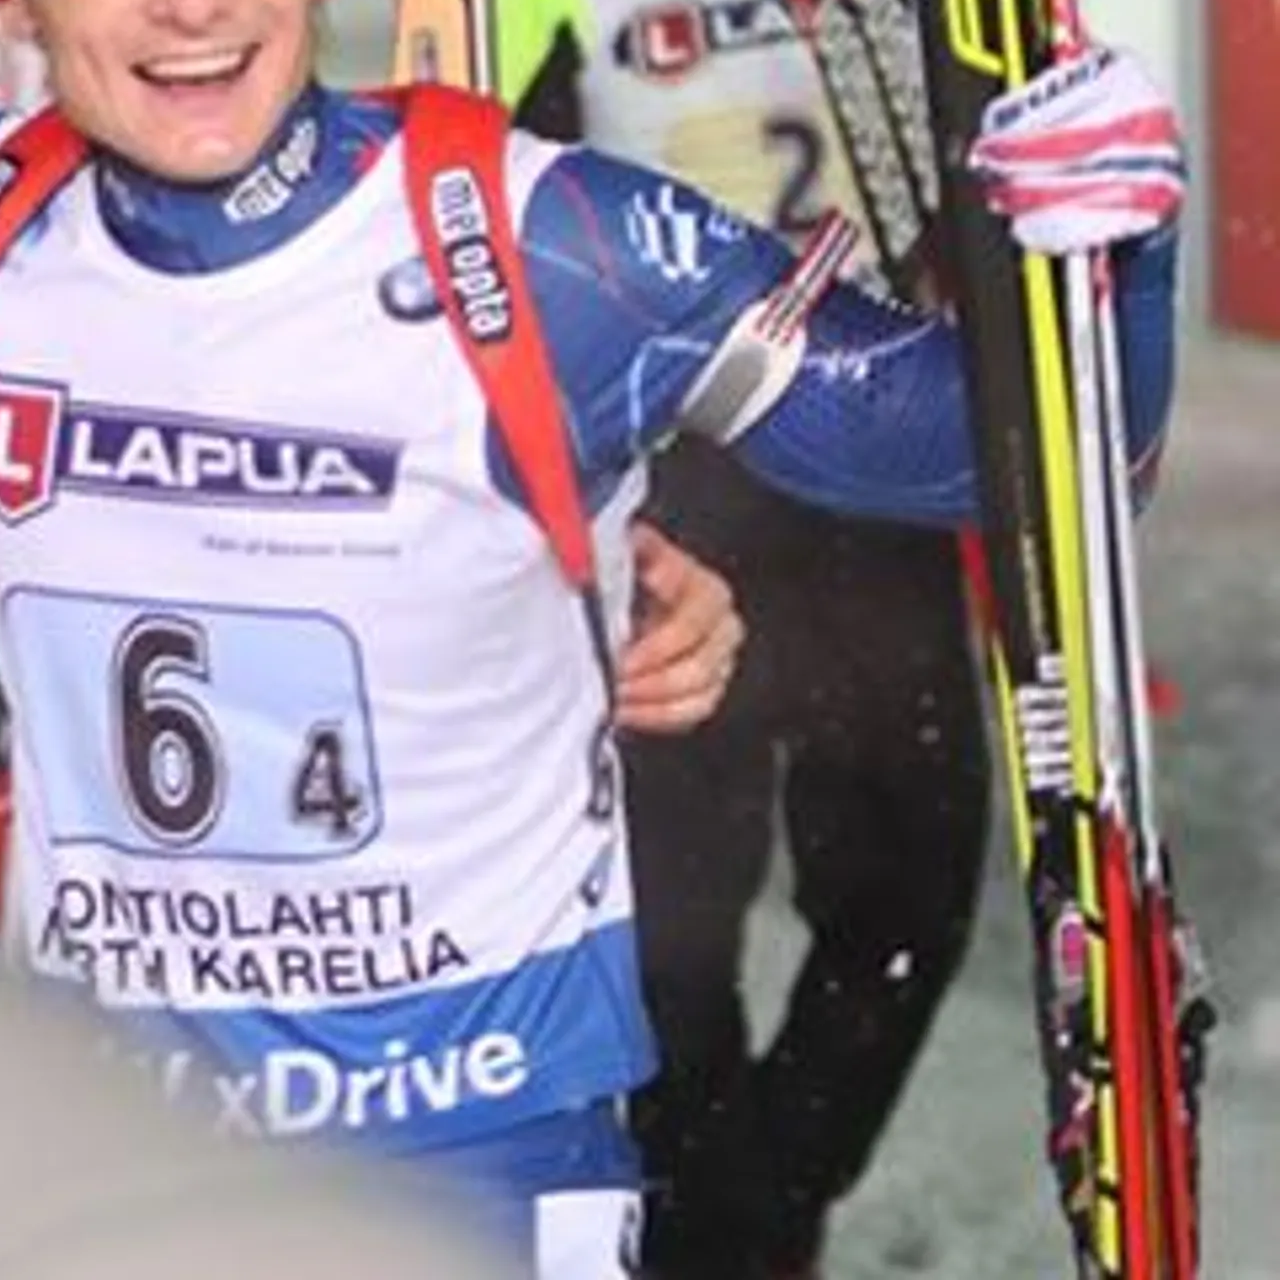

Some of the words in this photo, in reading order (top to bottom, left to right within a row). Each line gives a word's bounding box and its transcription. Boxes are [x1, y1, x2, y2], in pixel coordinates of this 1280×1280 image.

[763, 109, 824, 231] 2
[69, 421, 377, 495] LAPUA
[114, 613, 228, 849] 6
[292, 722, 366, 840] 4
[191, 933, 471, 1000] KARELIA
[214, 1031, 530, 1135] xDrive
